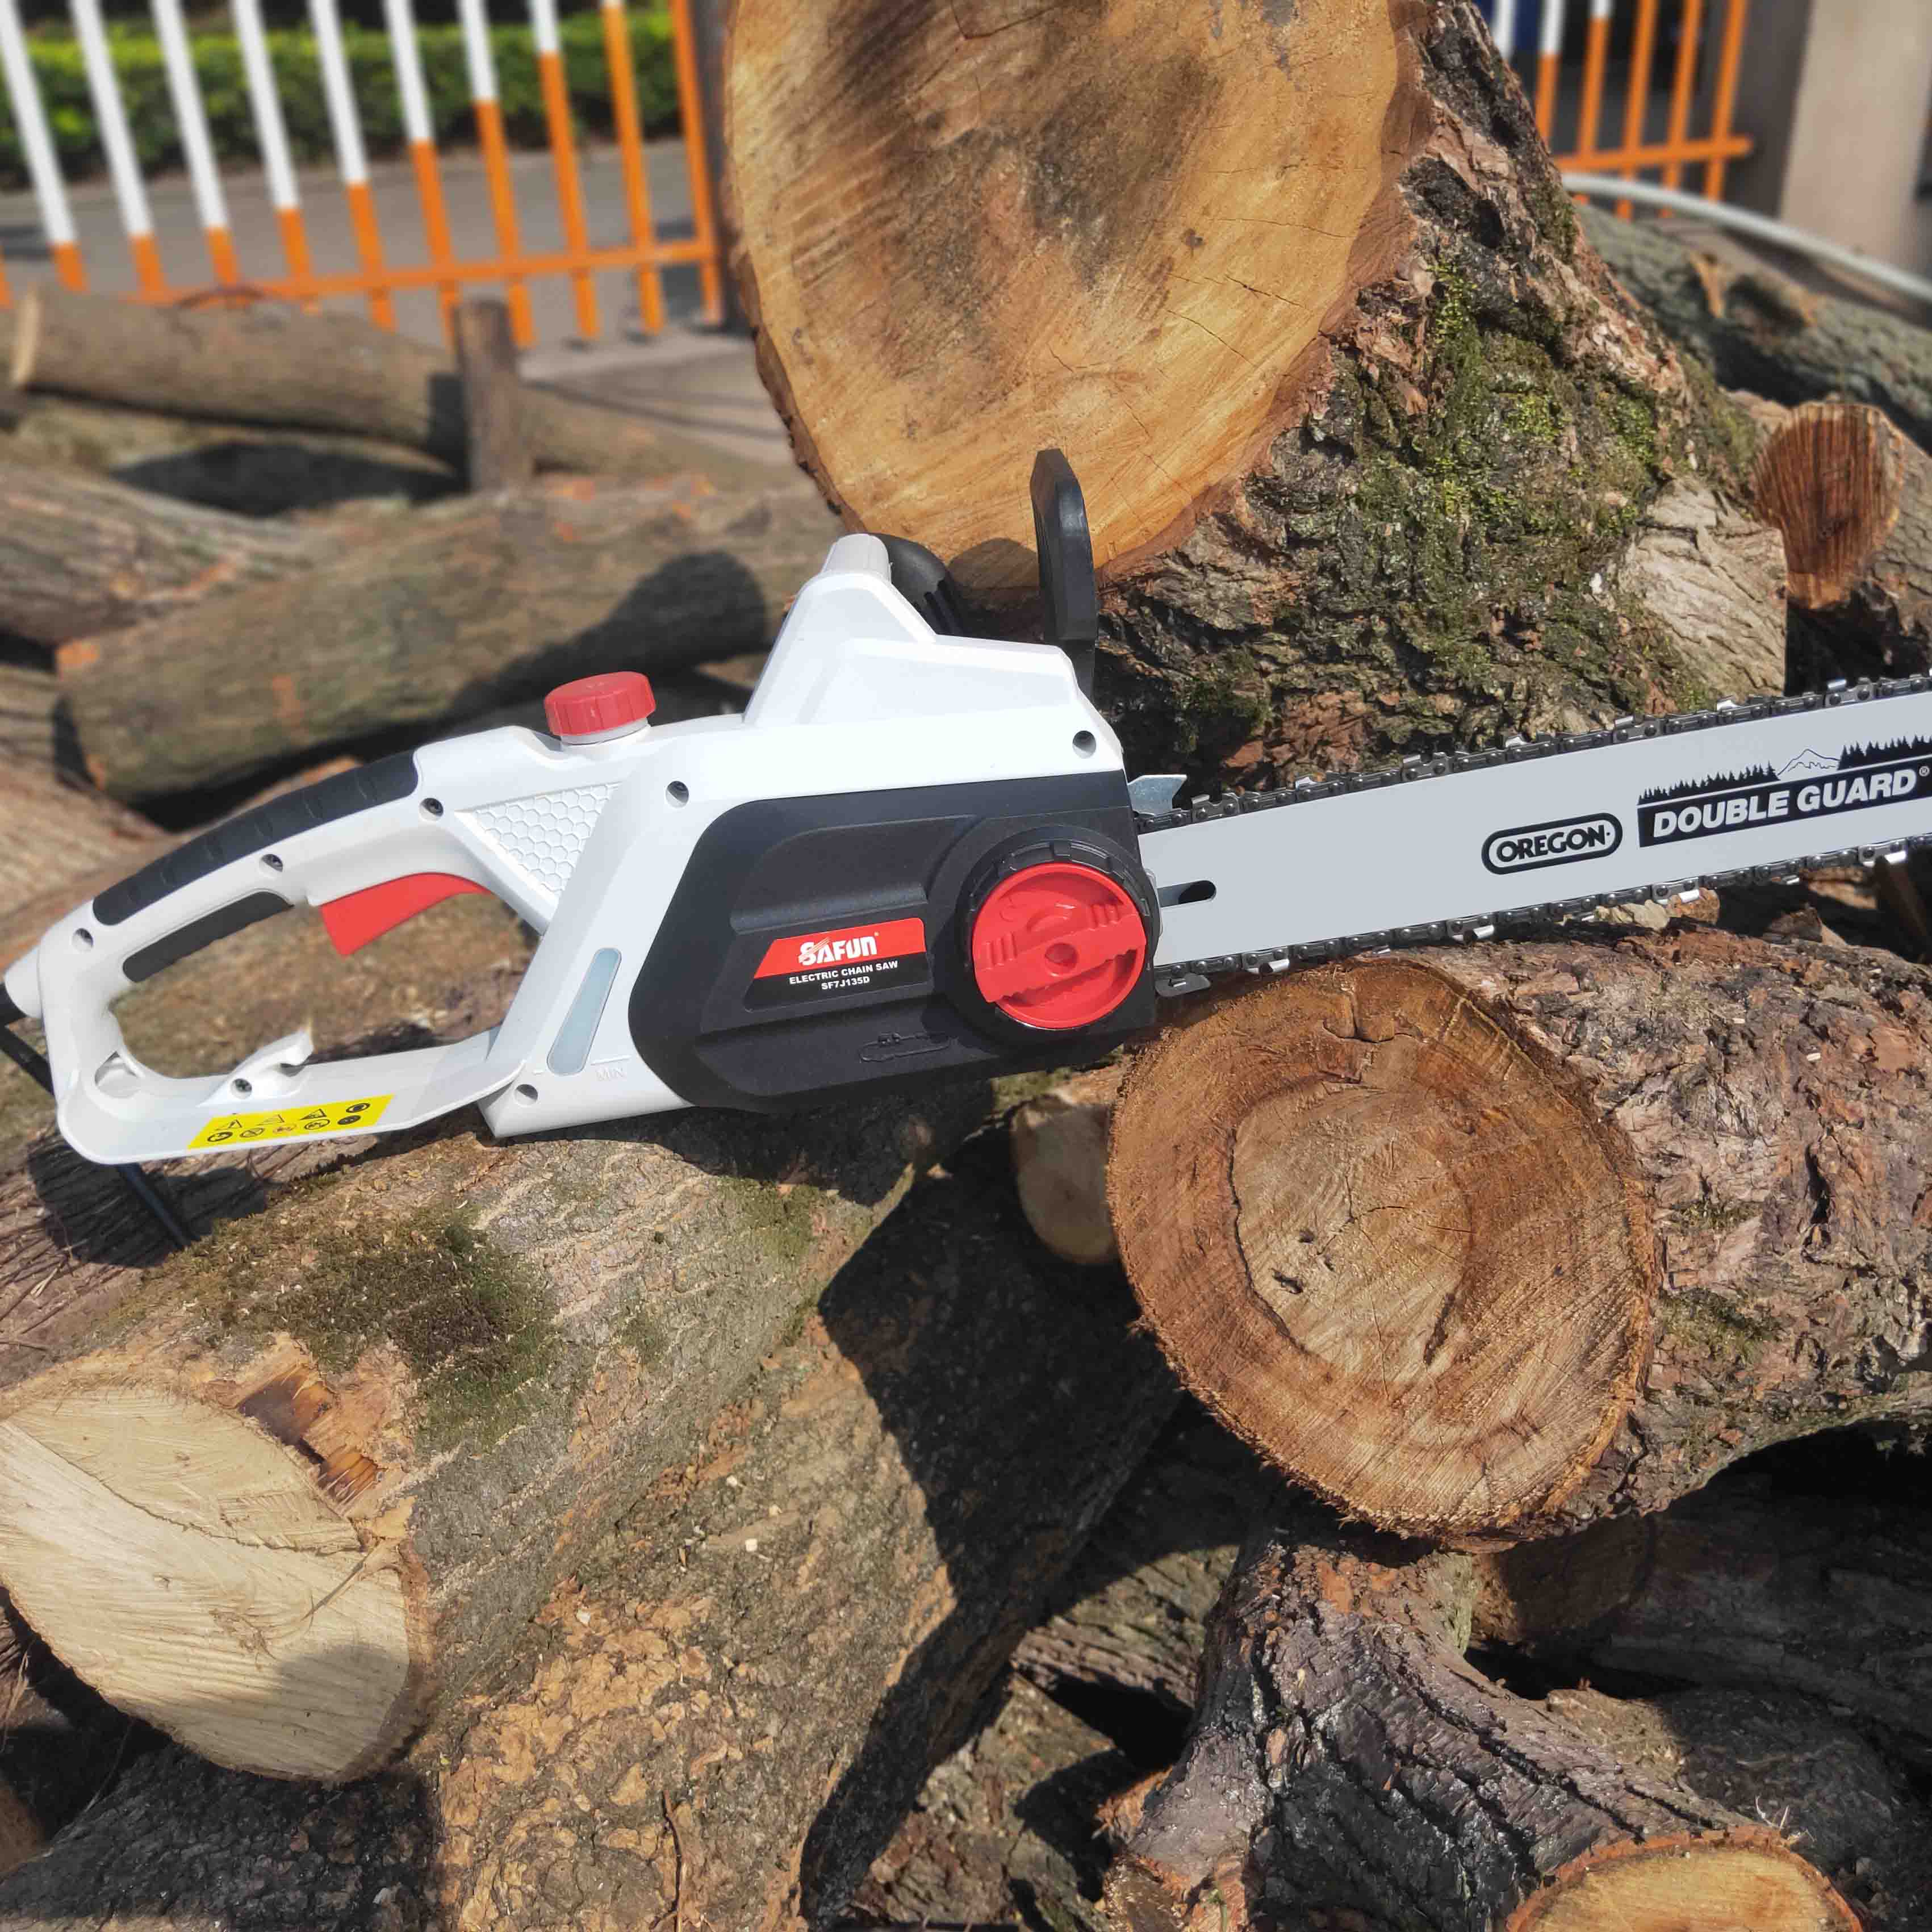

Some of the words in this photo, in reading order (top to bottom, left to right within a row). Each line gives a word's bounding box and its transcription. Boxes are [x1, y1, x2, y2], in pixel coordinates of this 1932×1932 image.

[1653, 790, 1789, 838] DOUBLE
[1496, 825, 1607, 863] OREGON
[789, 971, 839, 984] ELECTRIC
[841, 965, 873, 976] CHAIN
[876, 960, 898, 971] SAW
[821, 976, 870, 990] SF7J135D
